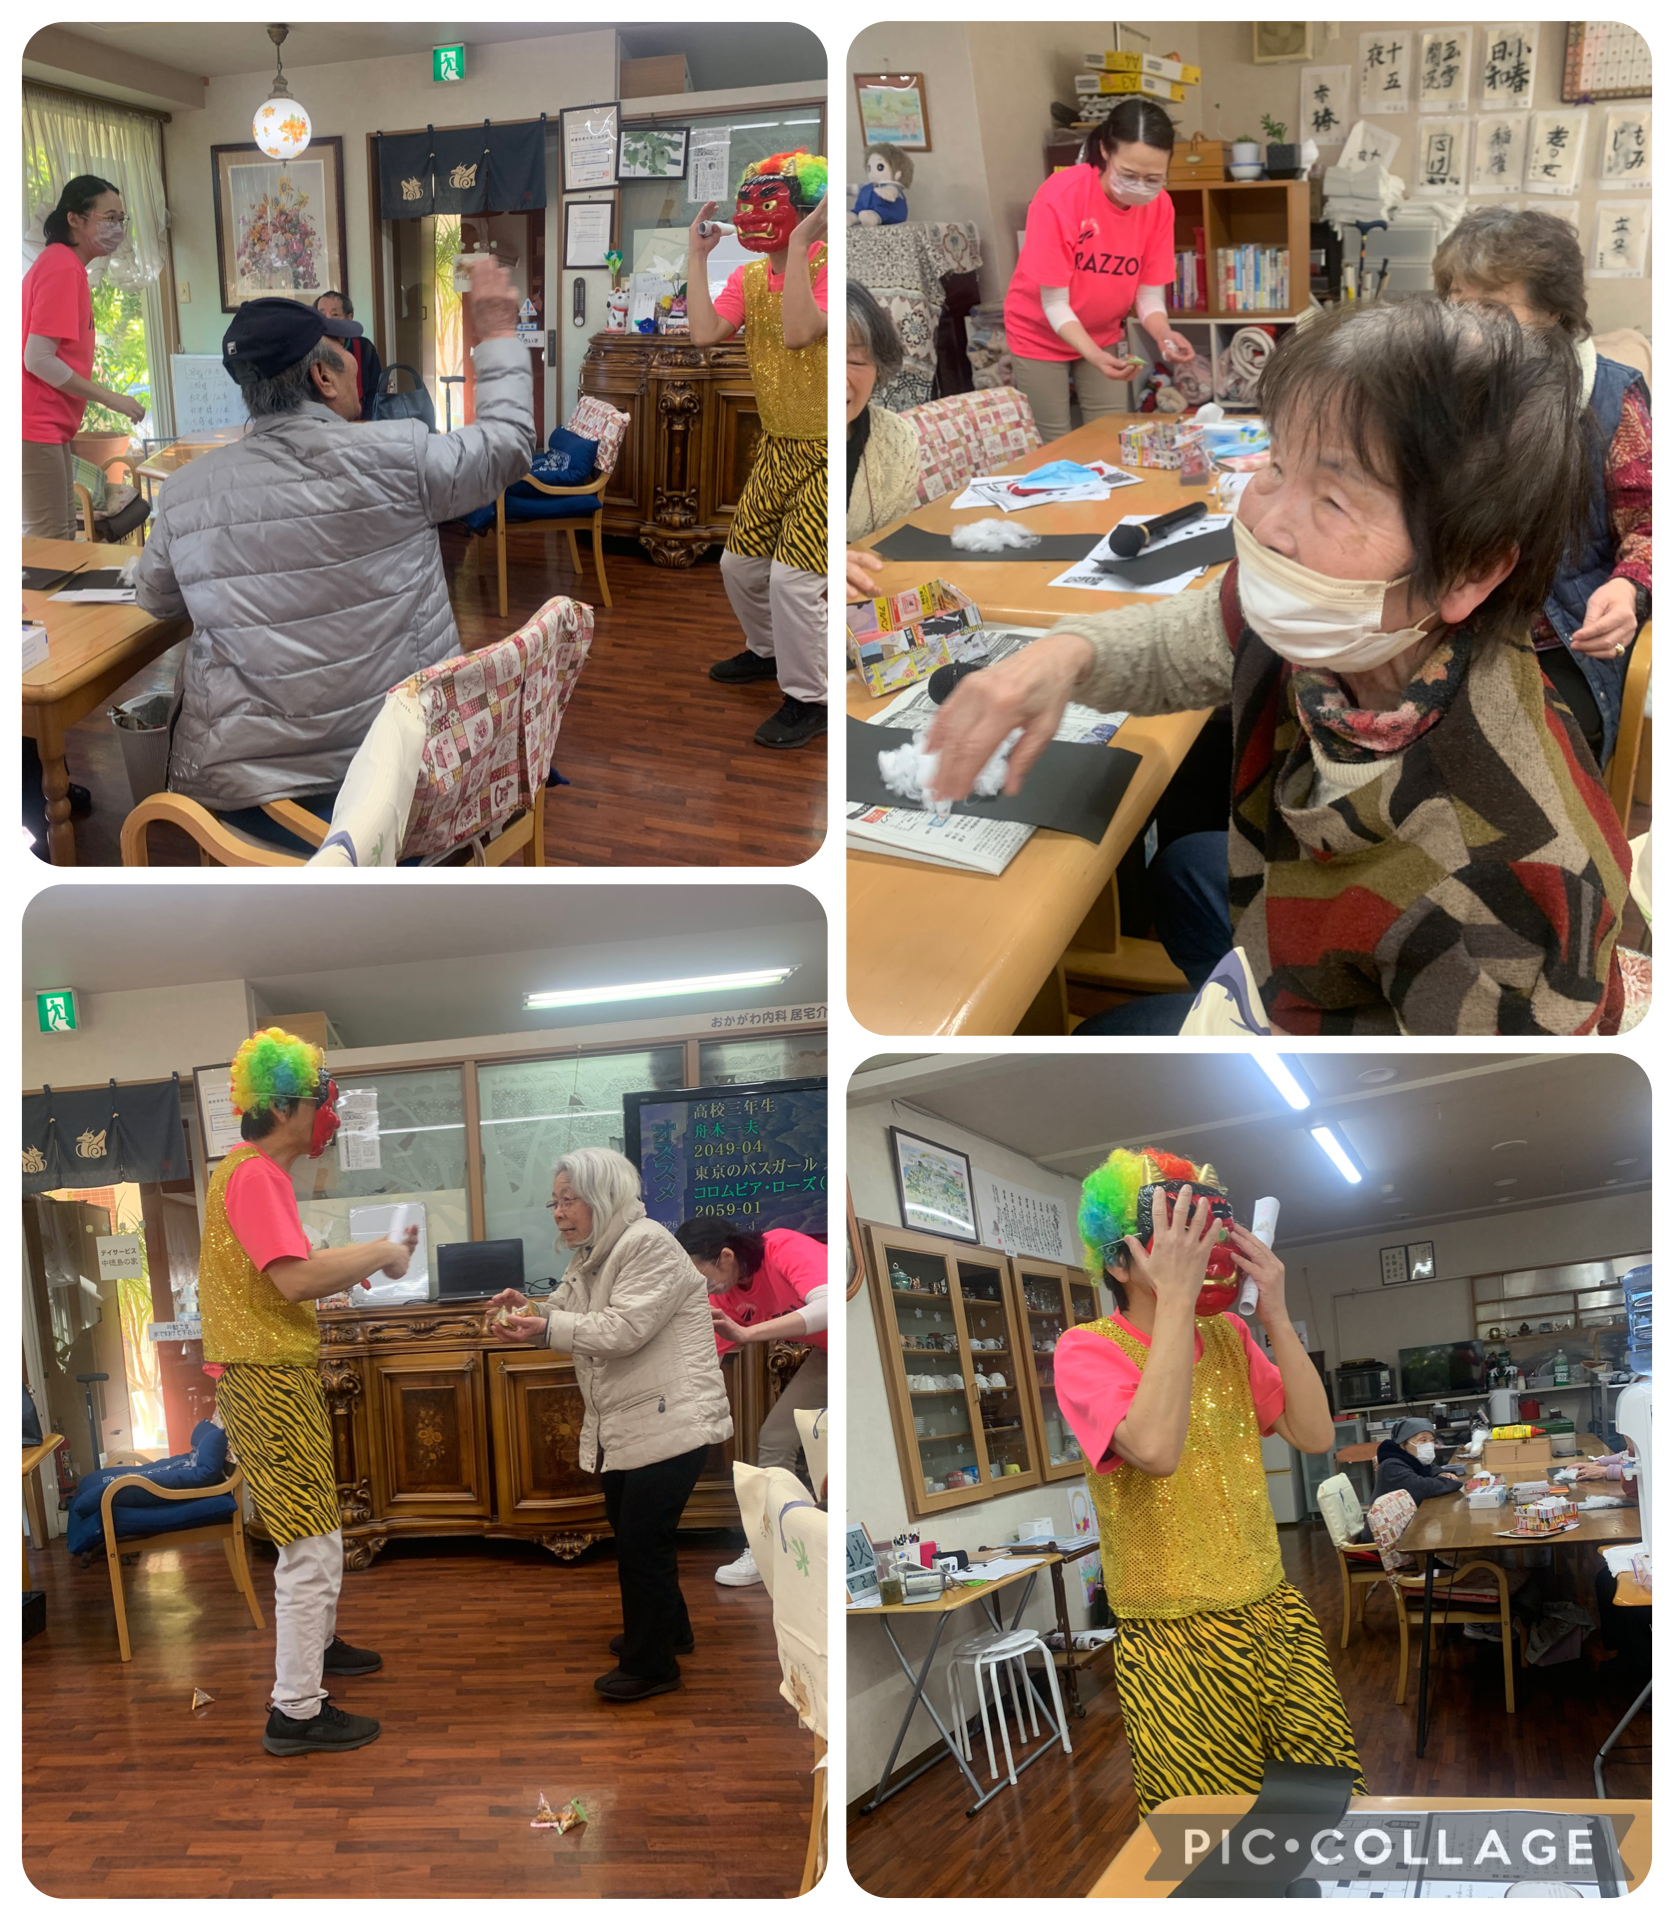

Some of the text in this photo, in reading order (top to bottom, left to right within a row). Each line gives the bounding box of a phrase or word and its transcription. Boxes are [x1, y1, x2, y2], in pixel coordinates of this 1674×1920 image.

[711, 1006, 828, 1028] おかがわ内科 居宅介
[693, 1098, 775, 1120] 高校三年生
[694, 1119, 759, 1139] 舟木一夫
[694, 1139, 763, 1158] 2049-04
[652, 1119, 677, 1202] オススメ
[694, 1157, 818, 1181] 東京のバスガール
[695, 1201, 761, 1217] 2059-01
[101, 1247, 137, 1257] デイサービス
